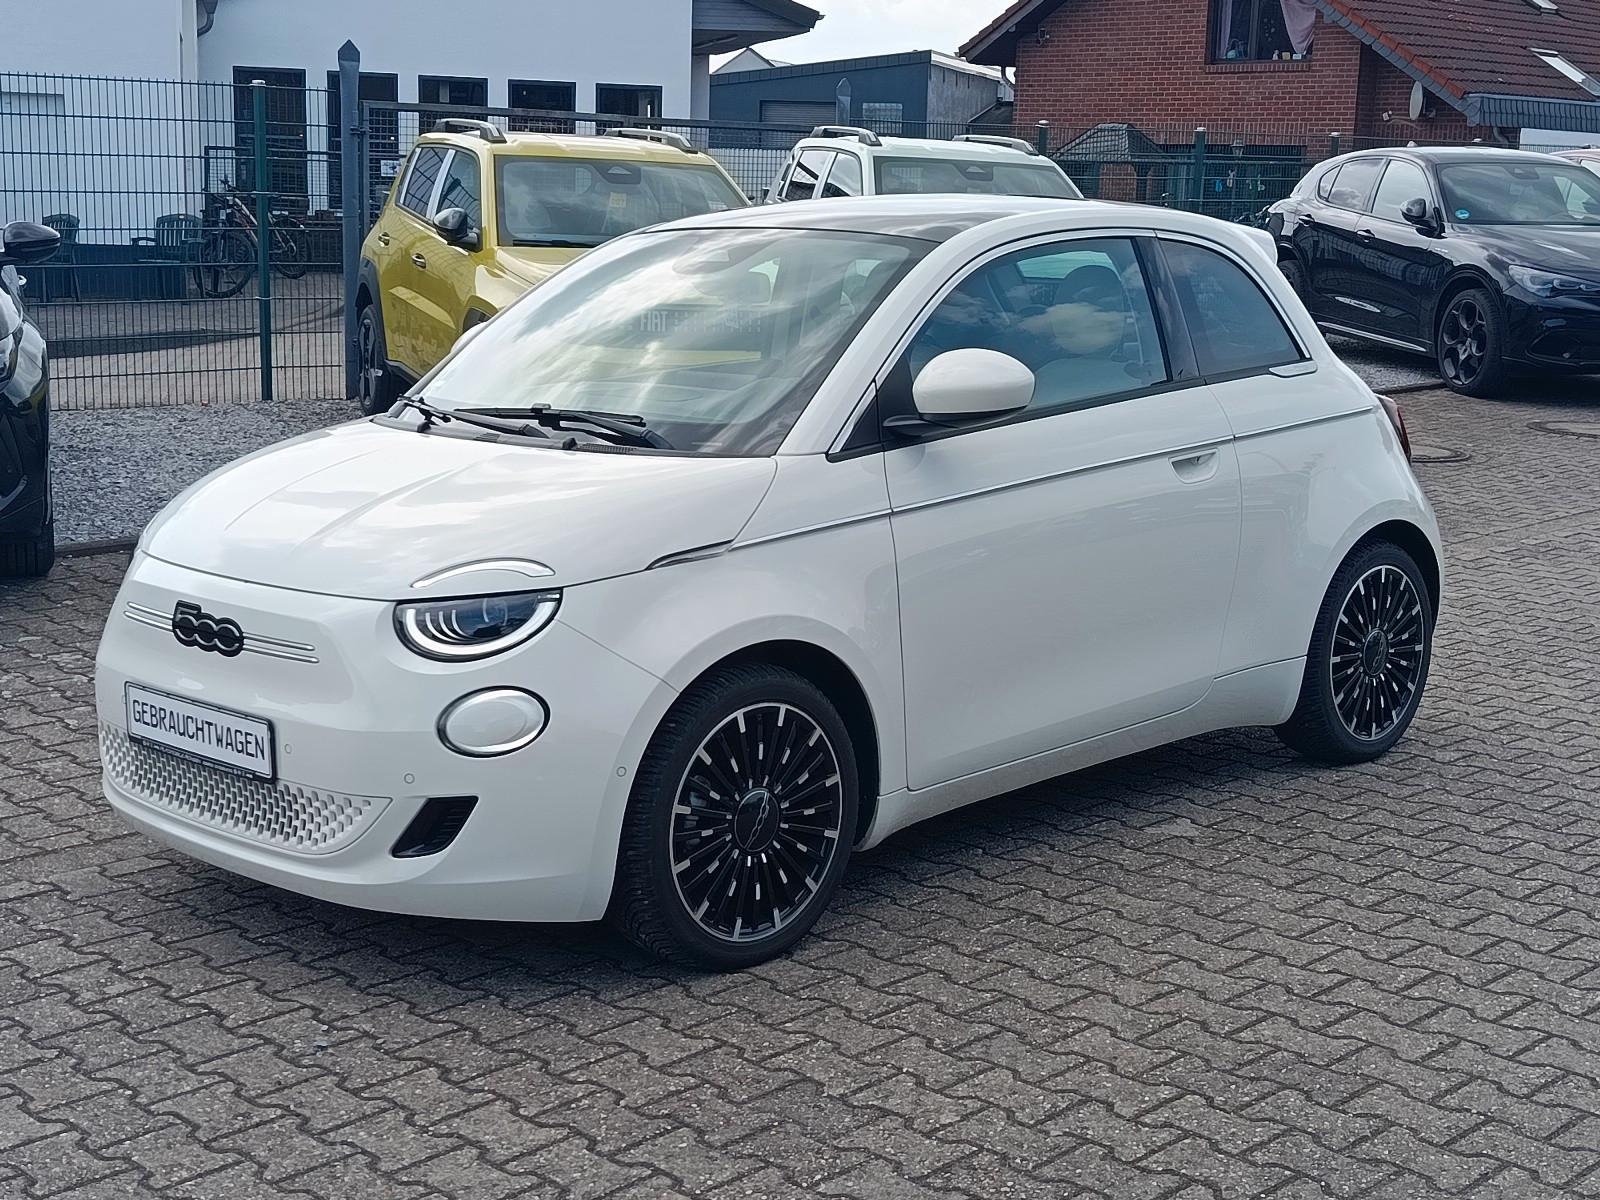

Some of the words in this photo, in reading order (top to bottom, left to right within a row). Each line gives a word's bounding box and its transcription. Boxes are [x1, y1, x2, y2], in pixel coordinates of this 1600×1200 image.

[640, 310, 669, 332] FIAT
[172, 600, 244, 657] 500
[132, 699, 265, 761] GEBRAUCHTWAGEN
